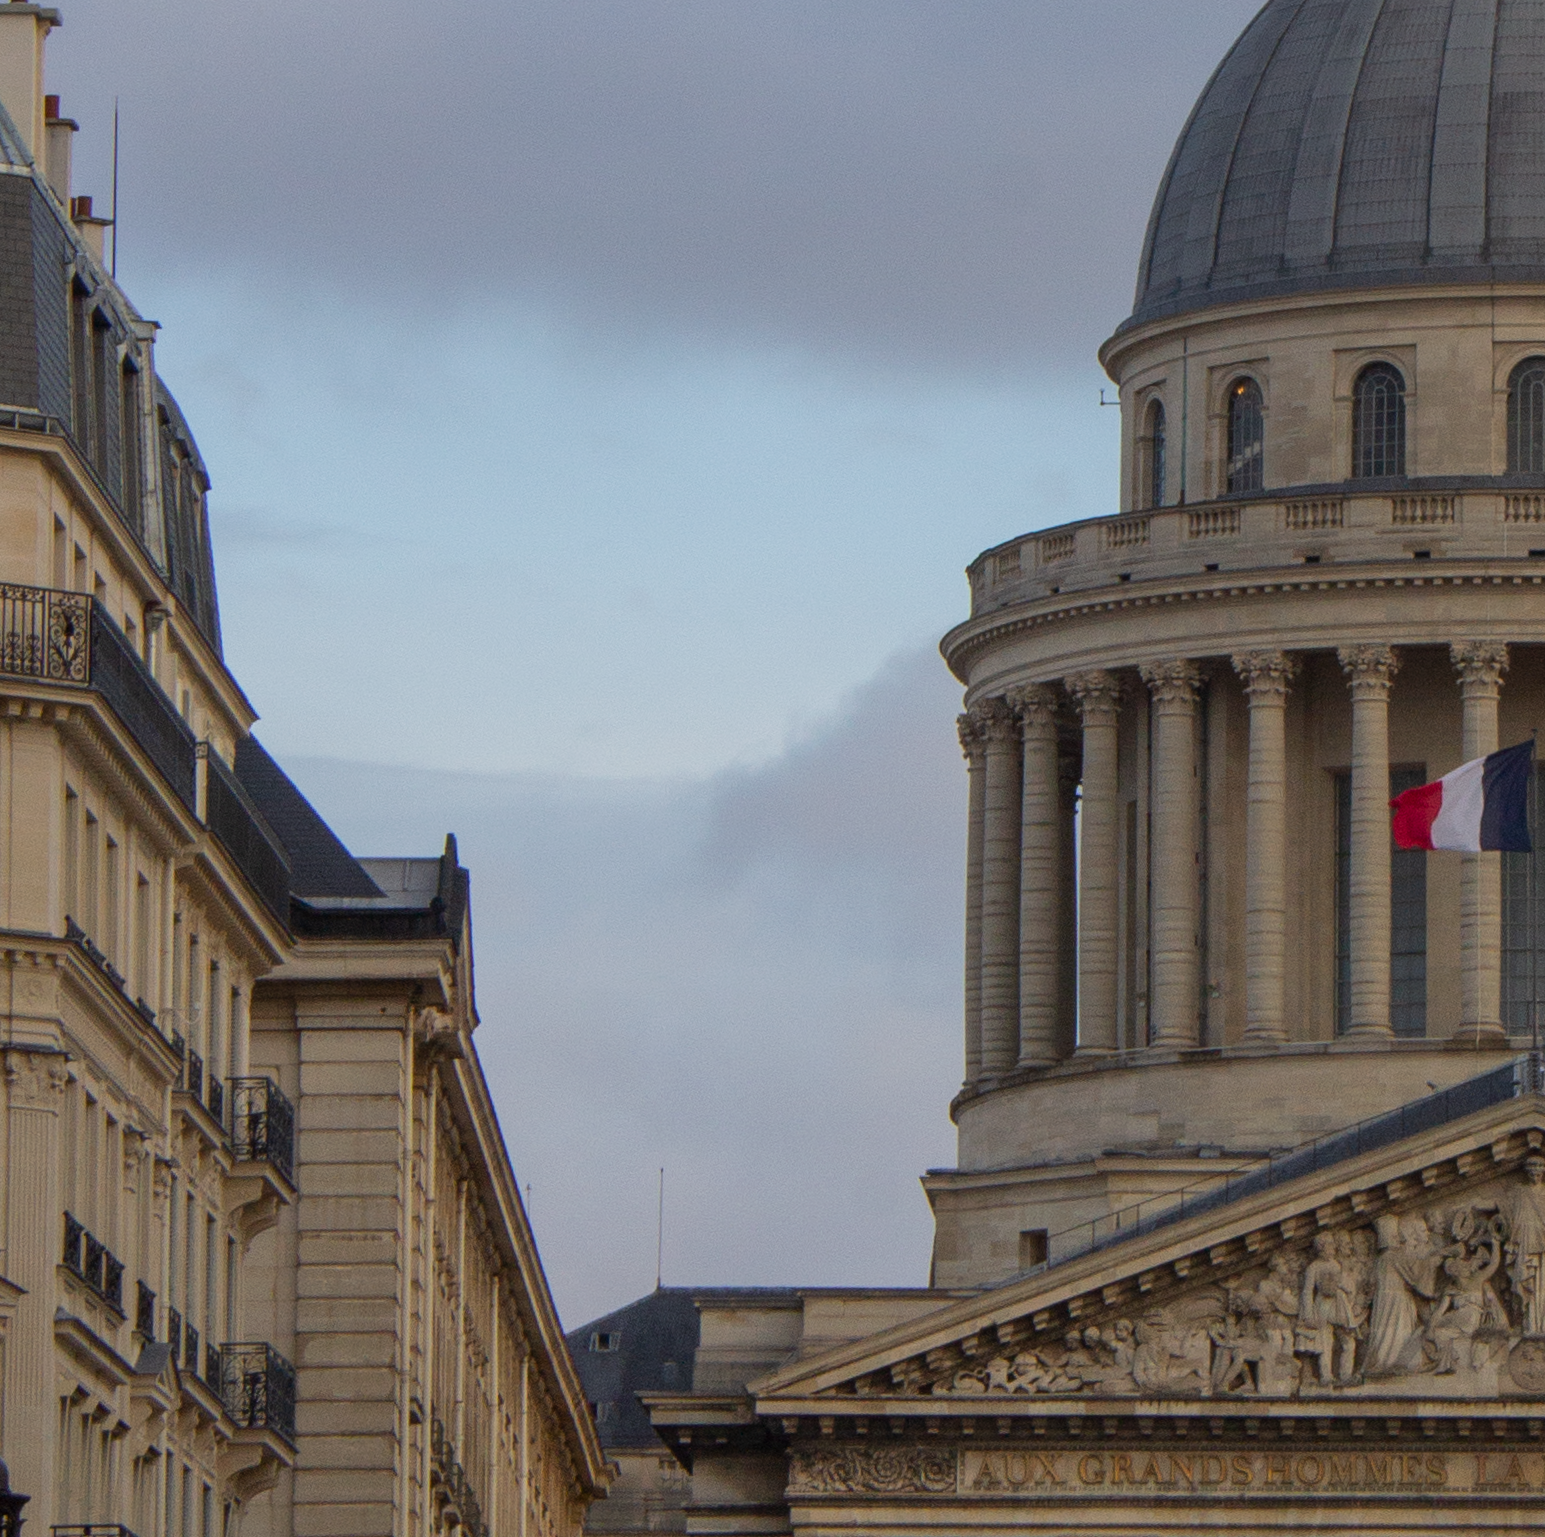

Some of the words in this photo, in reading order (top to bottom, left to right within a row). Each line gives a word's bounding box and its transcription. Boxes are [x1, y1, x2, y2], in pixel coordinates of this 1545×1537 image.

[973, 1453, 1068, 1486] AUX
[1077, 1453, 1254, 1486] GRANDS
[1263, 1454, 1448, 1487] HOMMES
[1474, 1454, 1529, 1487] LA
